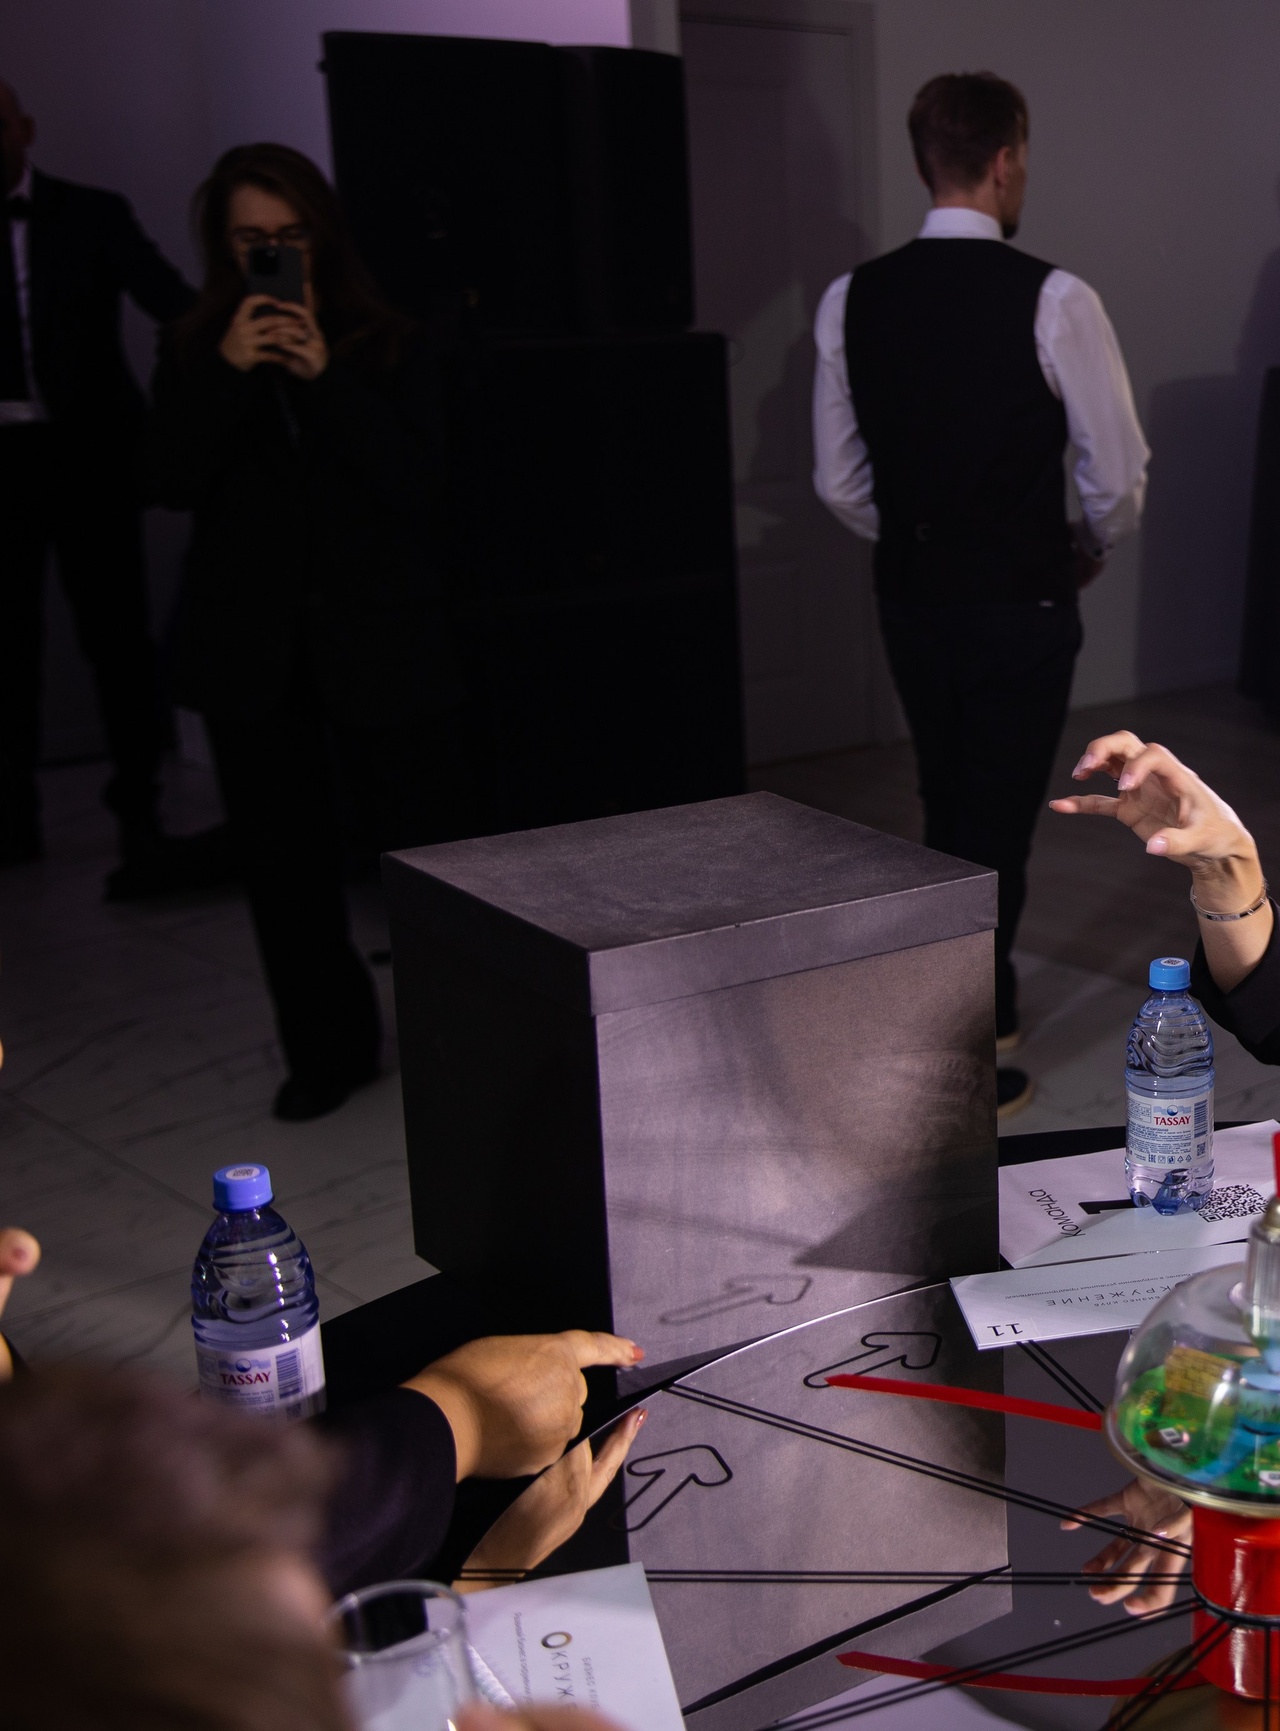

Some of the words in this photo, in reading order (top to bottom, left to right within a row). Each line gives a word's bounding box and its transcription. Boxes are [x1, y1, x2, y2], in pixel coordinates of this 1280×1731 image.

[1153, 1115, 1191, 1126] TASSAY
[1028, 1189, 1086, 1238] Команда
[1046, 1284, 1175, 1306] КРУЖЕНИЕ
[1123, 1296, 1160, 1304] БИЗНЕС
[987, 1322, 1024, 1337] 11
[220, 1372, 271, 1386] TASSAY
